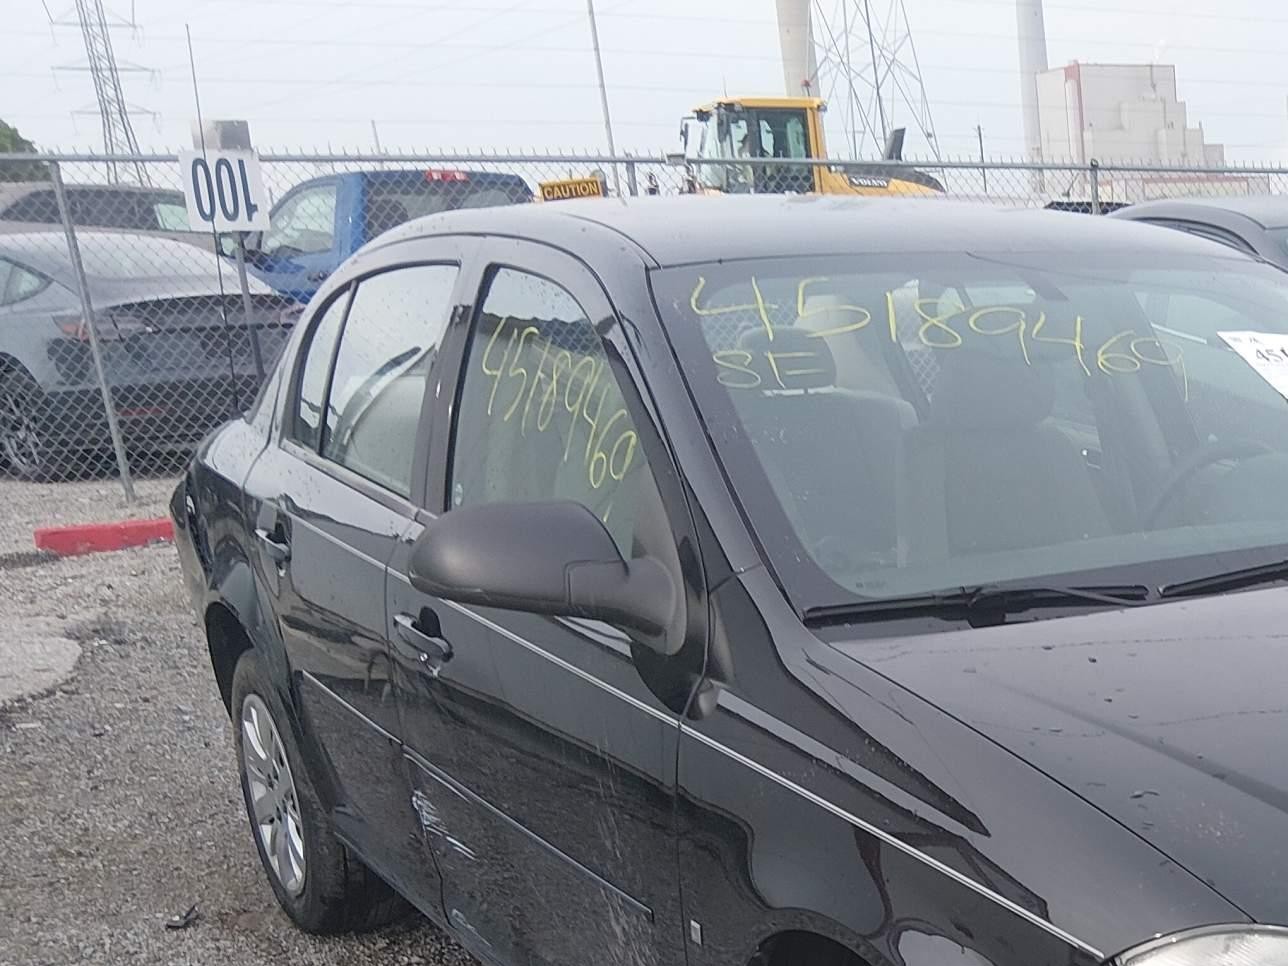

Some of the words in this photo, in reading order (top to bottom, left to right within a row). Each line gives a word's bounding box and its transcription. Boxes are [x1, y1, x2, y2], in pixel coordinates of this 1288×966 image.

[543, 181, 598, 200] CAUTION
[690, 276, 1189, 401] 45189469
[713, 350, 827, 389] SE
